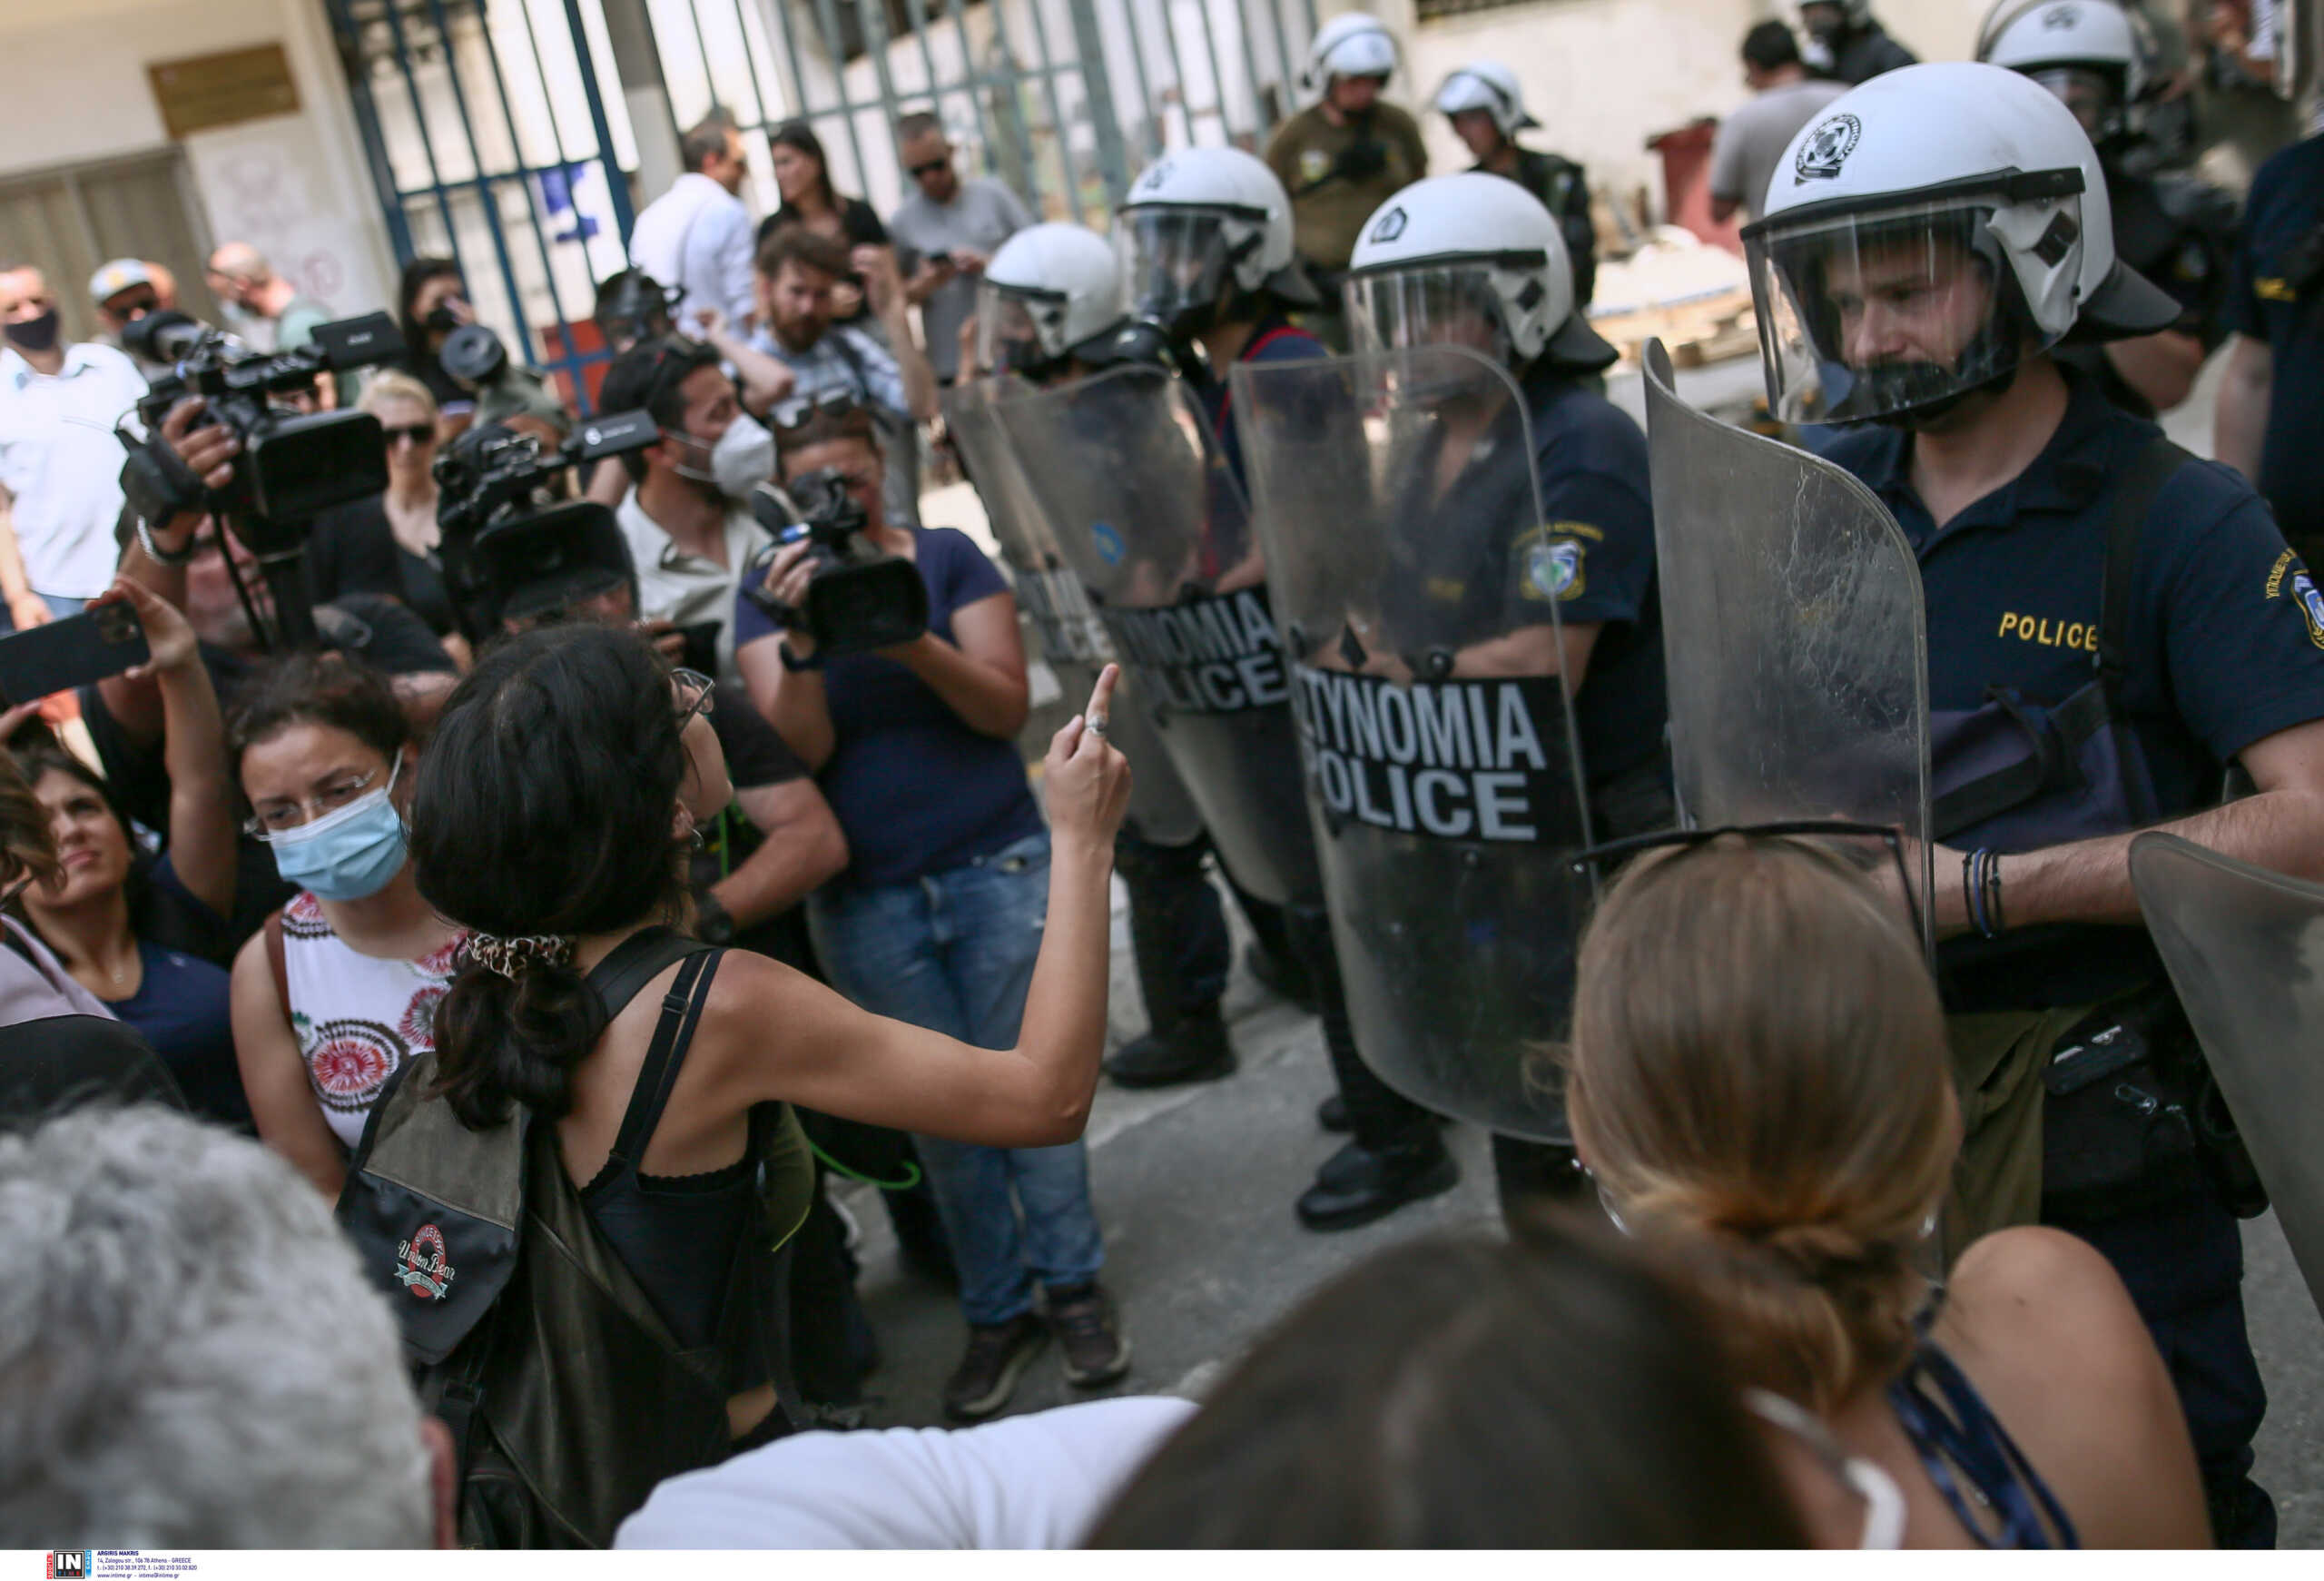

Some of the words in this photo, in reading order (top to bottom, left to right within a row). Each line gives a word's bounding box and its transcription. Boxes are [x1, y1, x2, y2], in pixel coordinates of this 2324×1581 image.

[1998, 611, 2098, 652] POLICE
[1292, 664, 1546, 771] TYNOMIA
[398, 1240, 429, 1270] Union
